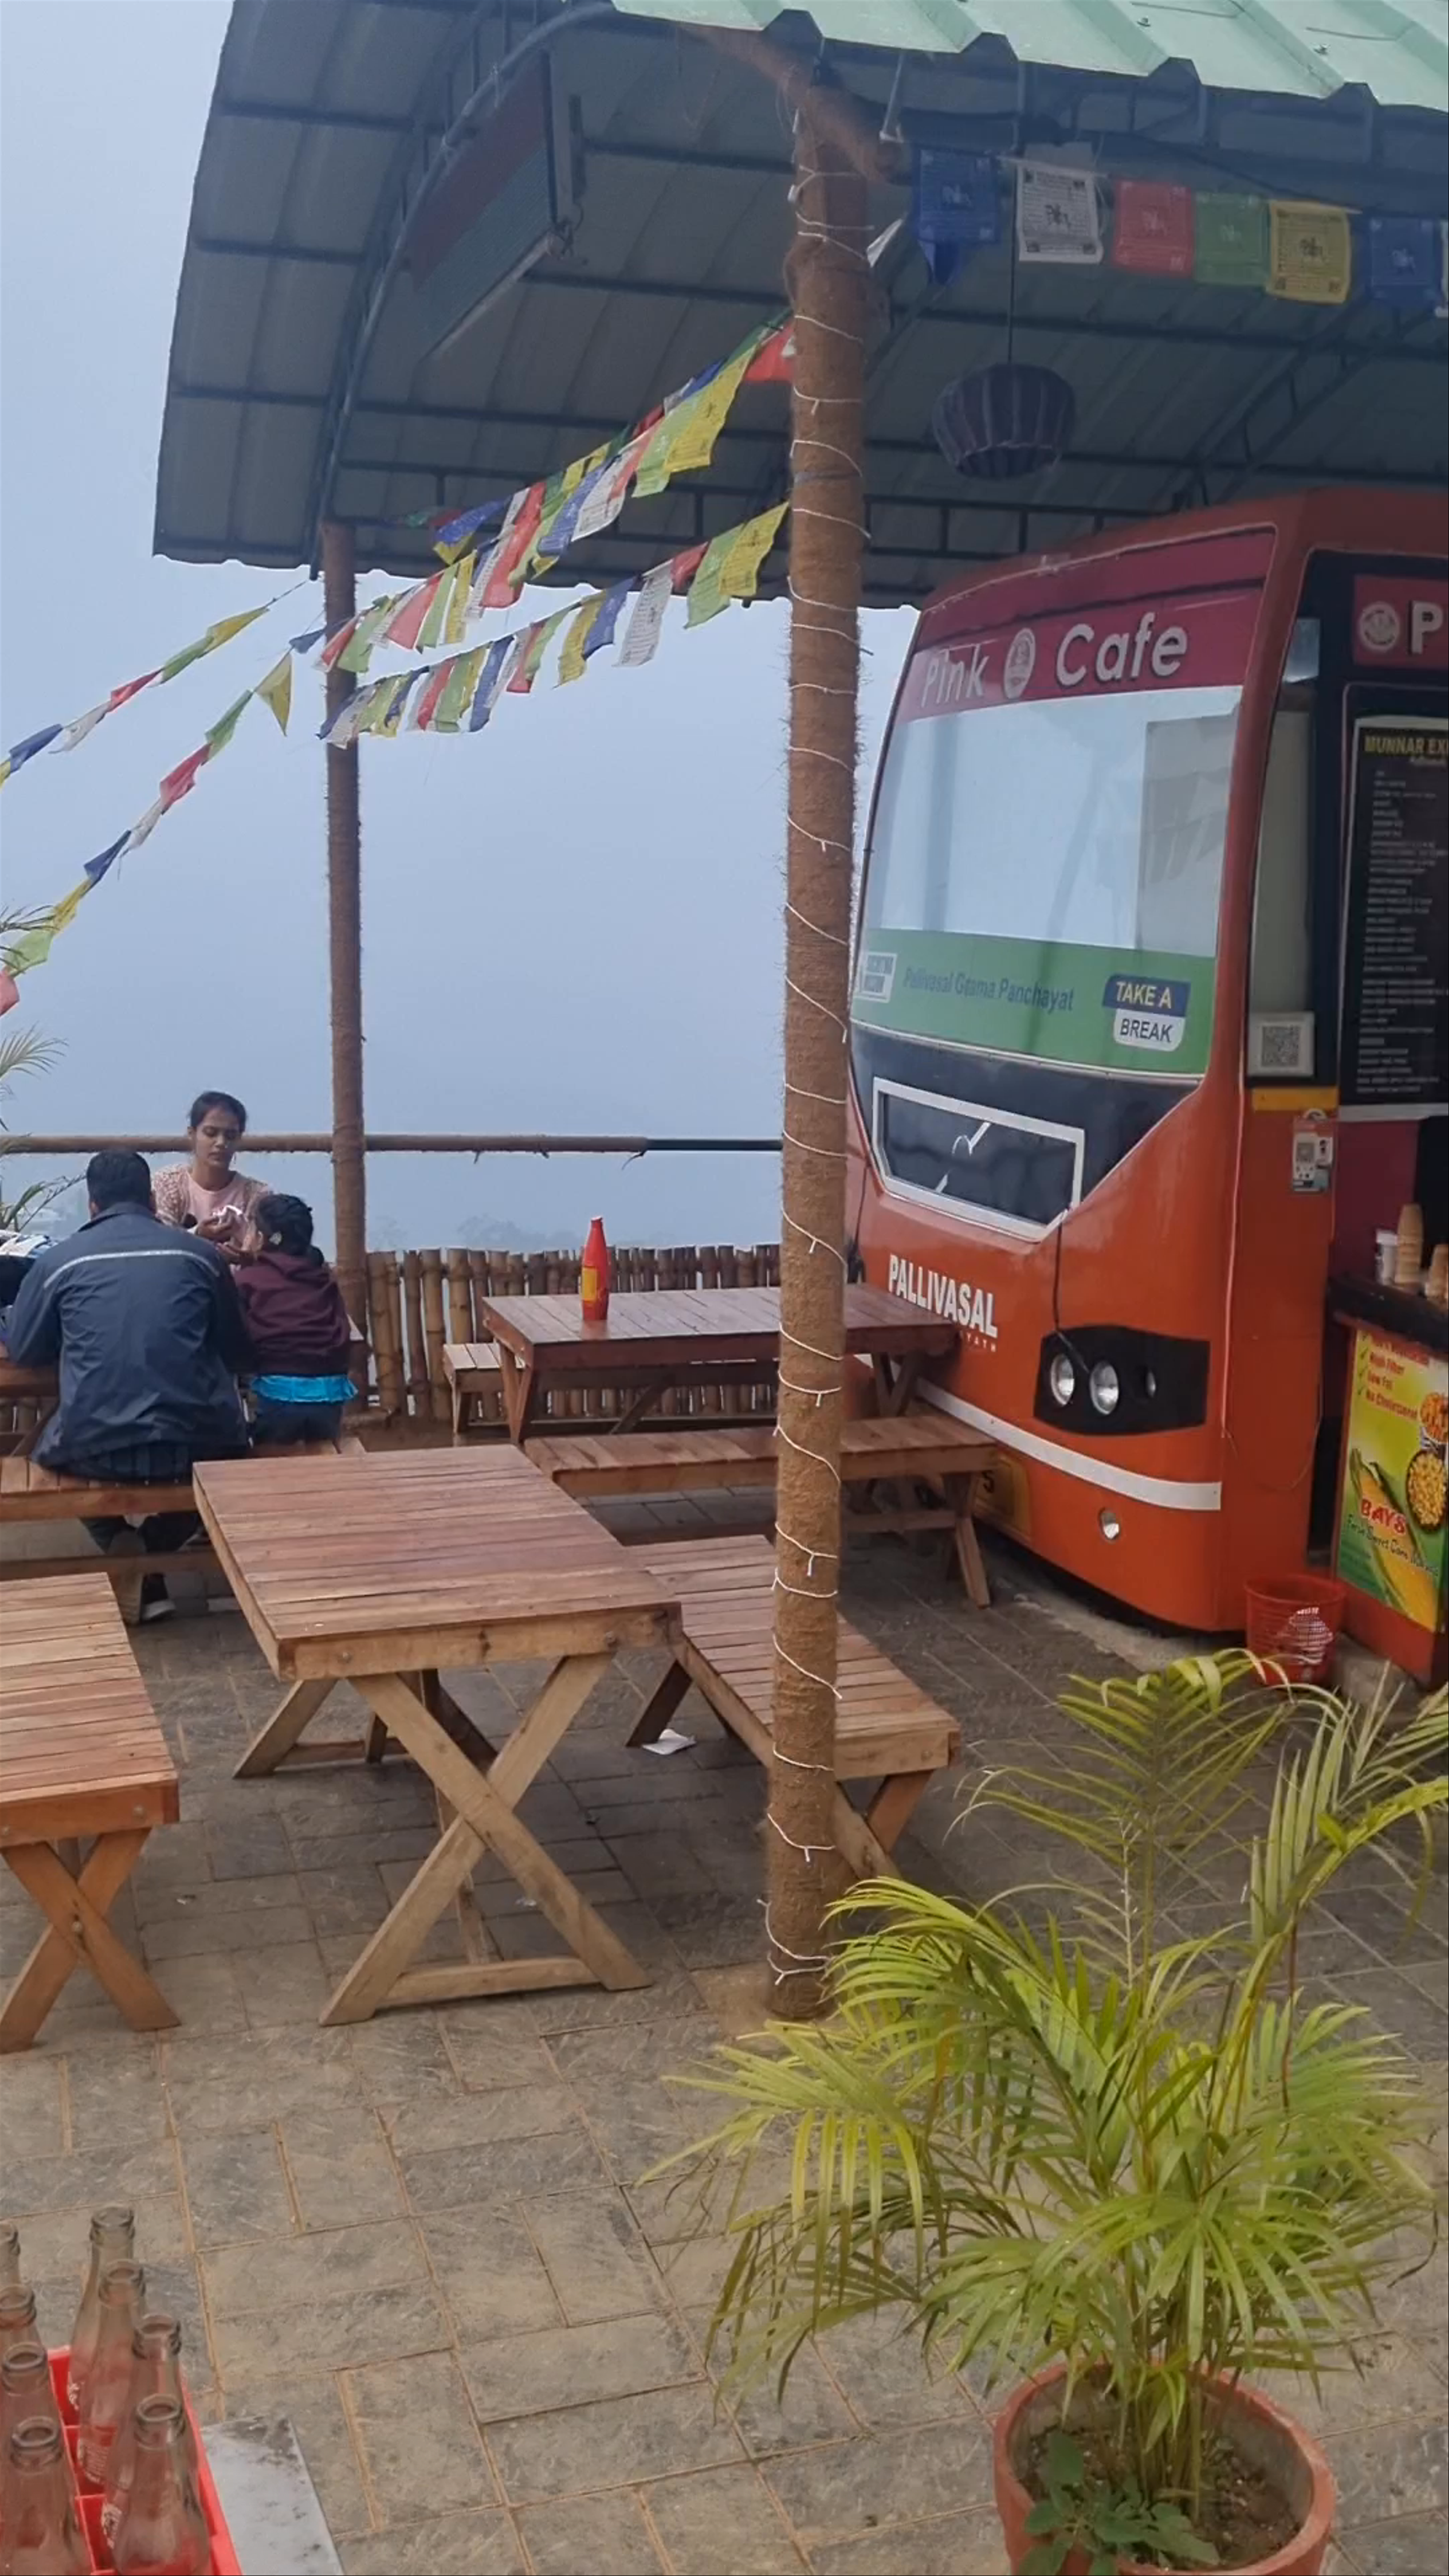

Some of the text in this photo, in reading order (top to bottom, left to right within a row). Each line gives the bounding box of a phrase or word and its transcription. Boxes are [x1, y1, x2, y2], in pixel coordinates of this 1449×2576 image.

[921, 643, 990, 707] Pink
[1057, 612, 1188, 686] Cafe
[1365, 735, 1449, 755] MUNNAR EX
[998, 978, 1074, 1014] Panchayat
[1116, 981, 1172, 1009] TAKE A
[1120, 1018, 1173, 1043] BREAK
[889, 1253, 998, 1338] PALLIVASAL
[1362, 1499, 1406, 1534] BAYS
